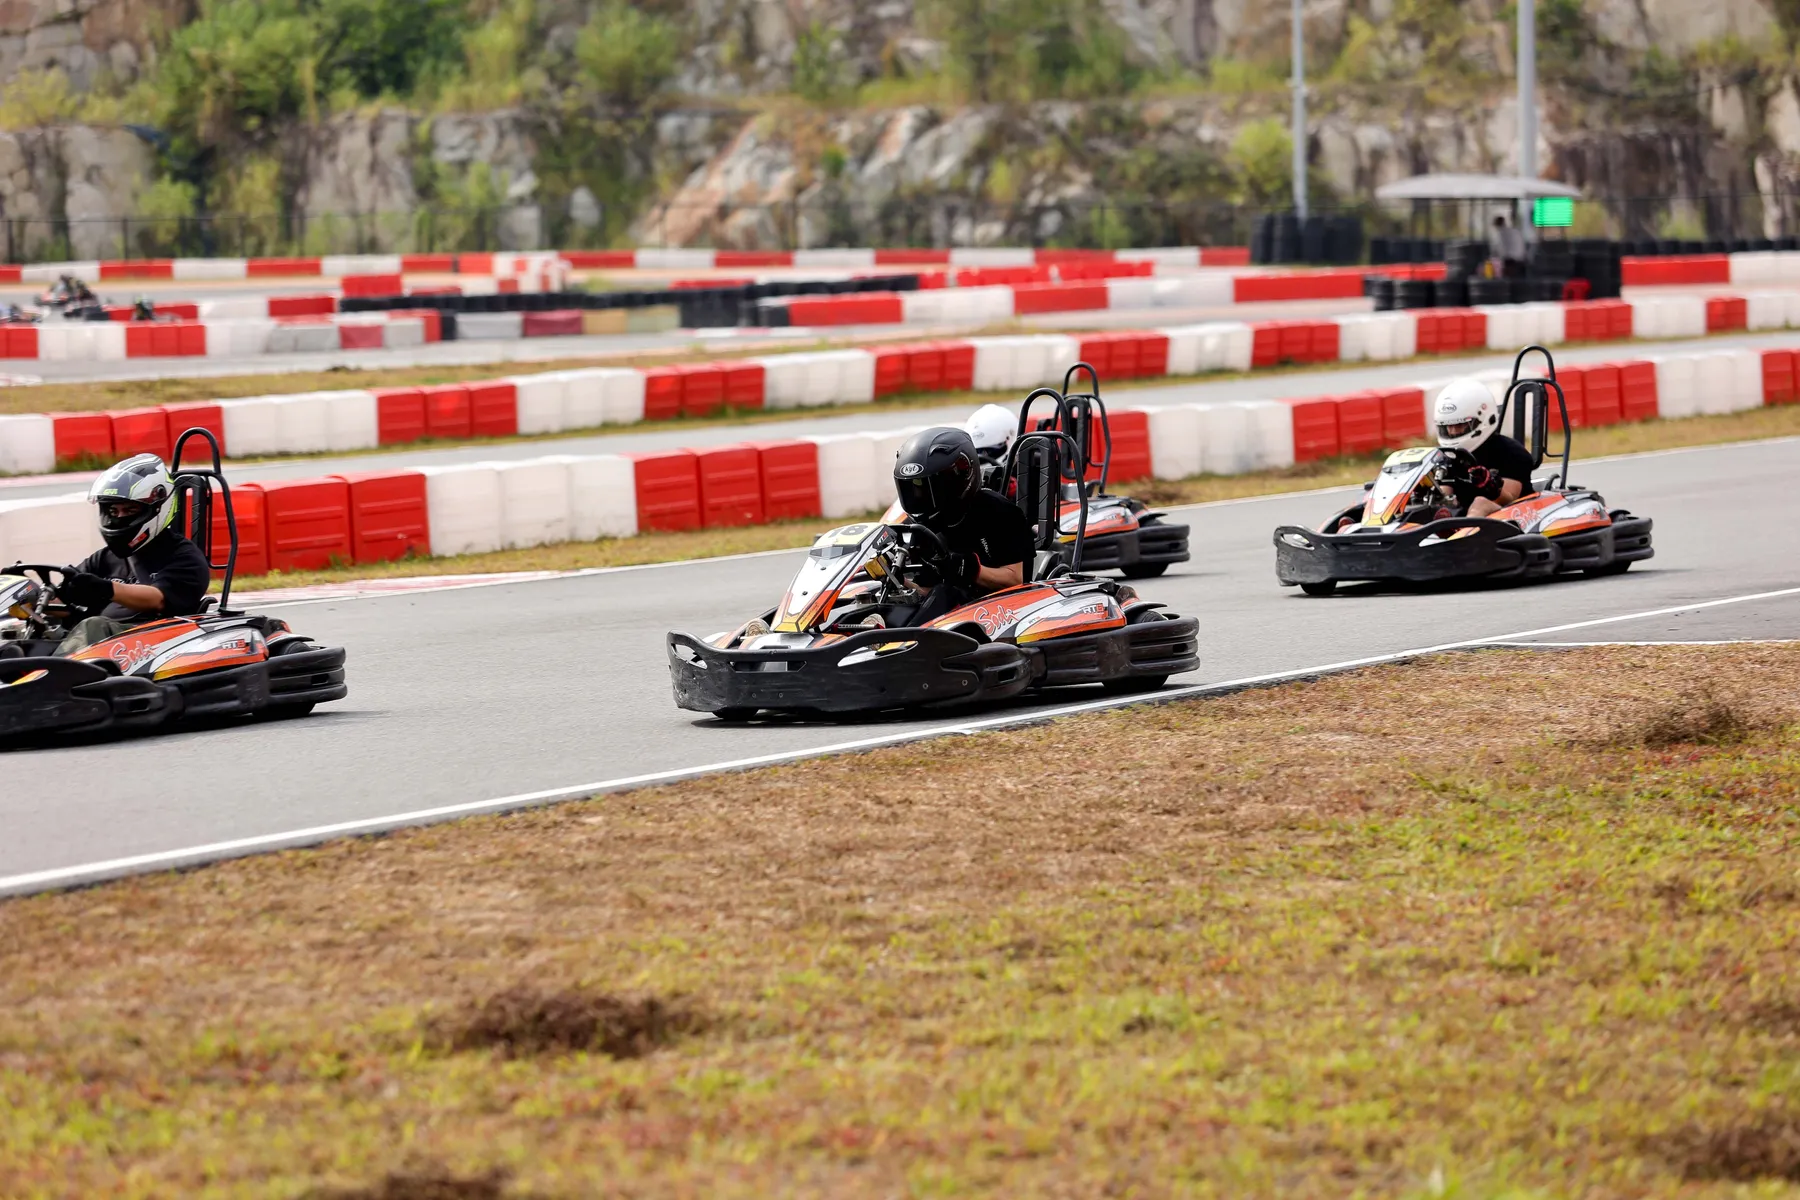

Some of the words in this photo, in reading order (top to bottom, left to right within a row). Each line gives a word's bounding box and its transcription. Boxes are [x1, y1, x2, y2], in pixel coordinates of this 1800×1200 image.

[828, 525, 868, 538] 18
[973, 605, 1018, 636] Sodi
[109, 640, 157, 672] Sodi
